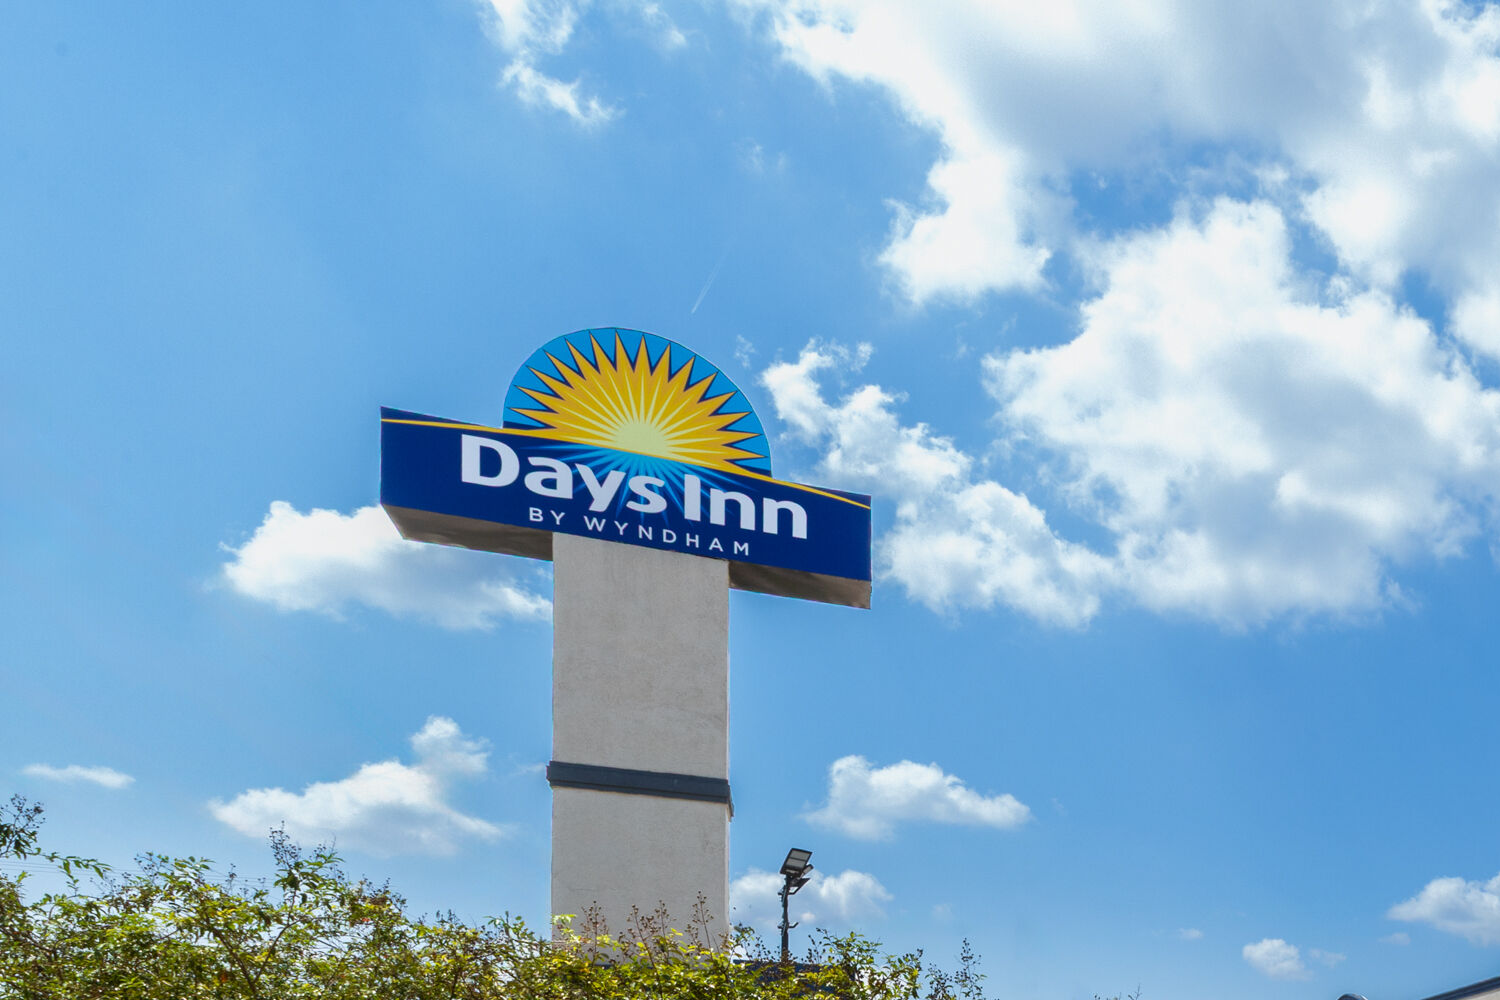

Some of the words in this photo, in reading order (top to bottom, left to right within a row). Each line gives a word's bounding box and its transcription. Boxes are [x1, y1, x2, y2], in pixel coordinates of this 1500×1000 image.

[461, 434, 667, 514] Days
[684, 474, 808, 539] Inn
[529, 507, 566, 525] BY
[584, 516, 750, 556] WYNDHAM
